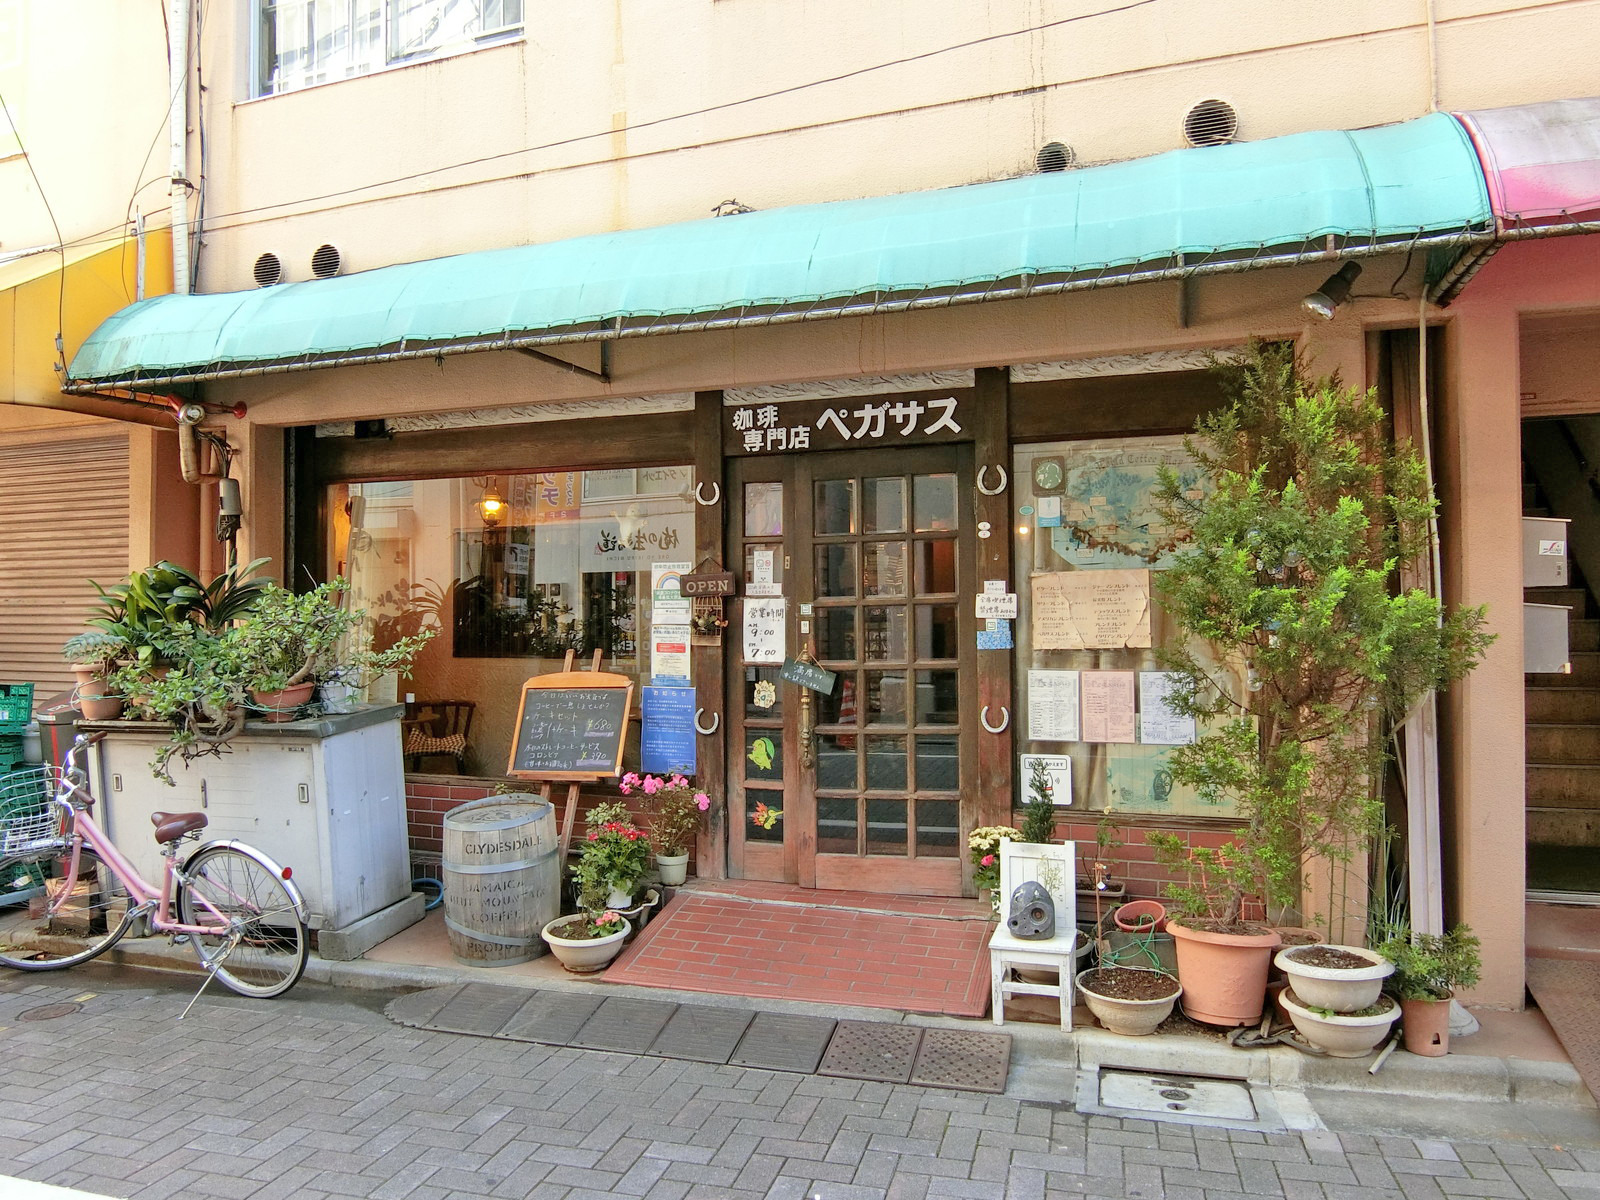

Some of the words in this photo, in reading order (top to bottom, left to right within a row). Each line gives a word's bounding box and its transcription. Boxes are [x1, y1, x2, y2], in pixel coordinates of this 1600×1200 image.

[732, 405, 779, 431] 珈琲
[815, 396, 962, 440] ペガサス
[743, 425, 811, 452] 専門店
[686, 580, 728, 593] OPEN
[748, 607, 784, 619] 営業時間
[751, 629, 775, 637] 9:00
[751, 648, 776, 658] 7:00
[465, 836, 542, 855] CLYDESDALE
[472, 910, 521, 923] COFFEE
